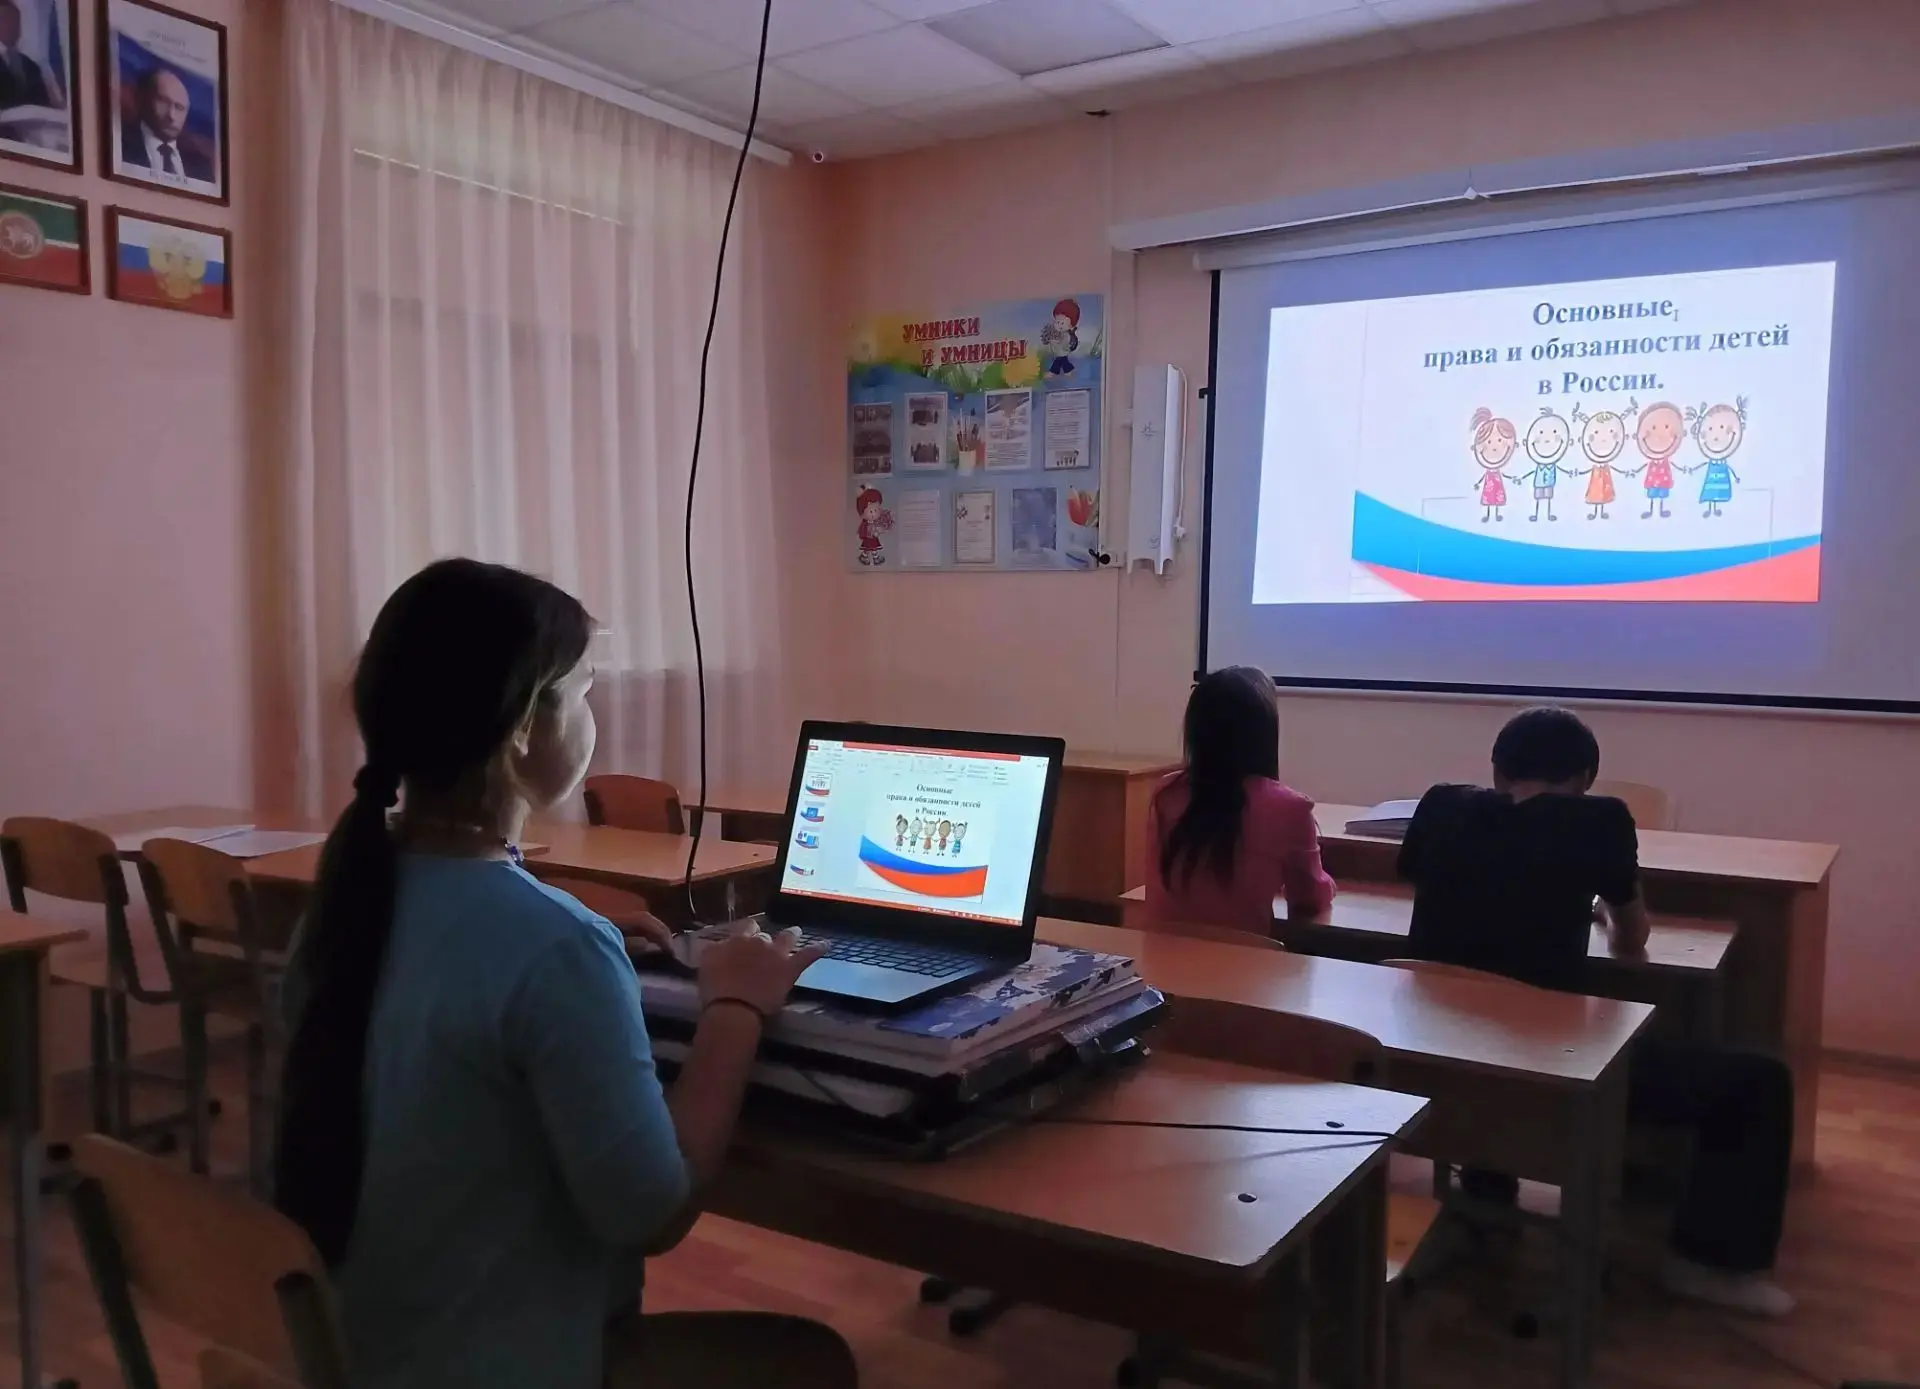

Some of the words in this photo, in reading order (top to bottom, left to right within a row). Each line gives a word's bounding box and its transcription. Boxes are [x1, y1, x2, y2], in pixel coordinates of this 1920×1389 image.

[902, 317, 980, 343] УМНИКИ
[921, 348, 934, 367] И
[940, 339, 1028, 366] УМНИЦЫ
[1423, 346, 1498, 372] права
[1507, 344, 1522, 362] и
[1530, 334, 1701, 362] обязанности
[1708, 323, 1790, 352] детей
[1537, 378, 1552, 395] в
[1561, 371, 1665, 395] России.
